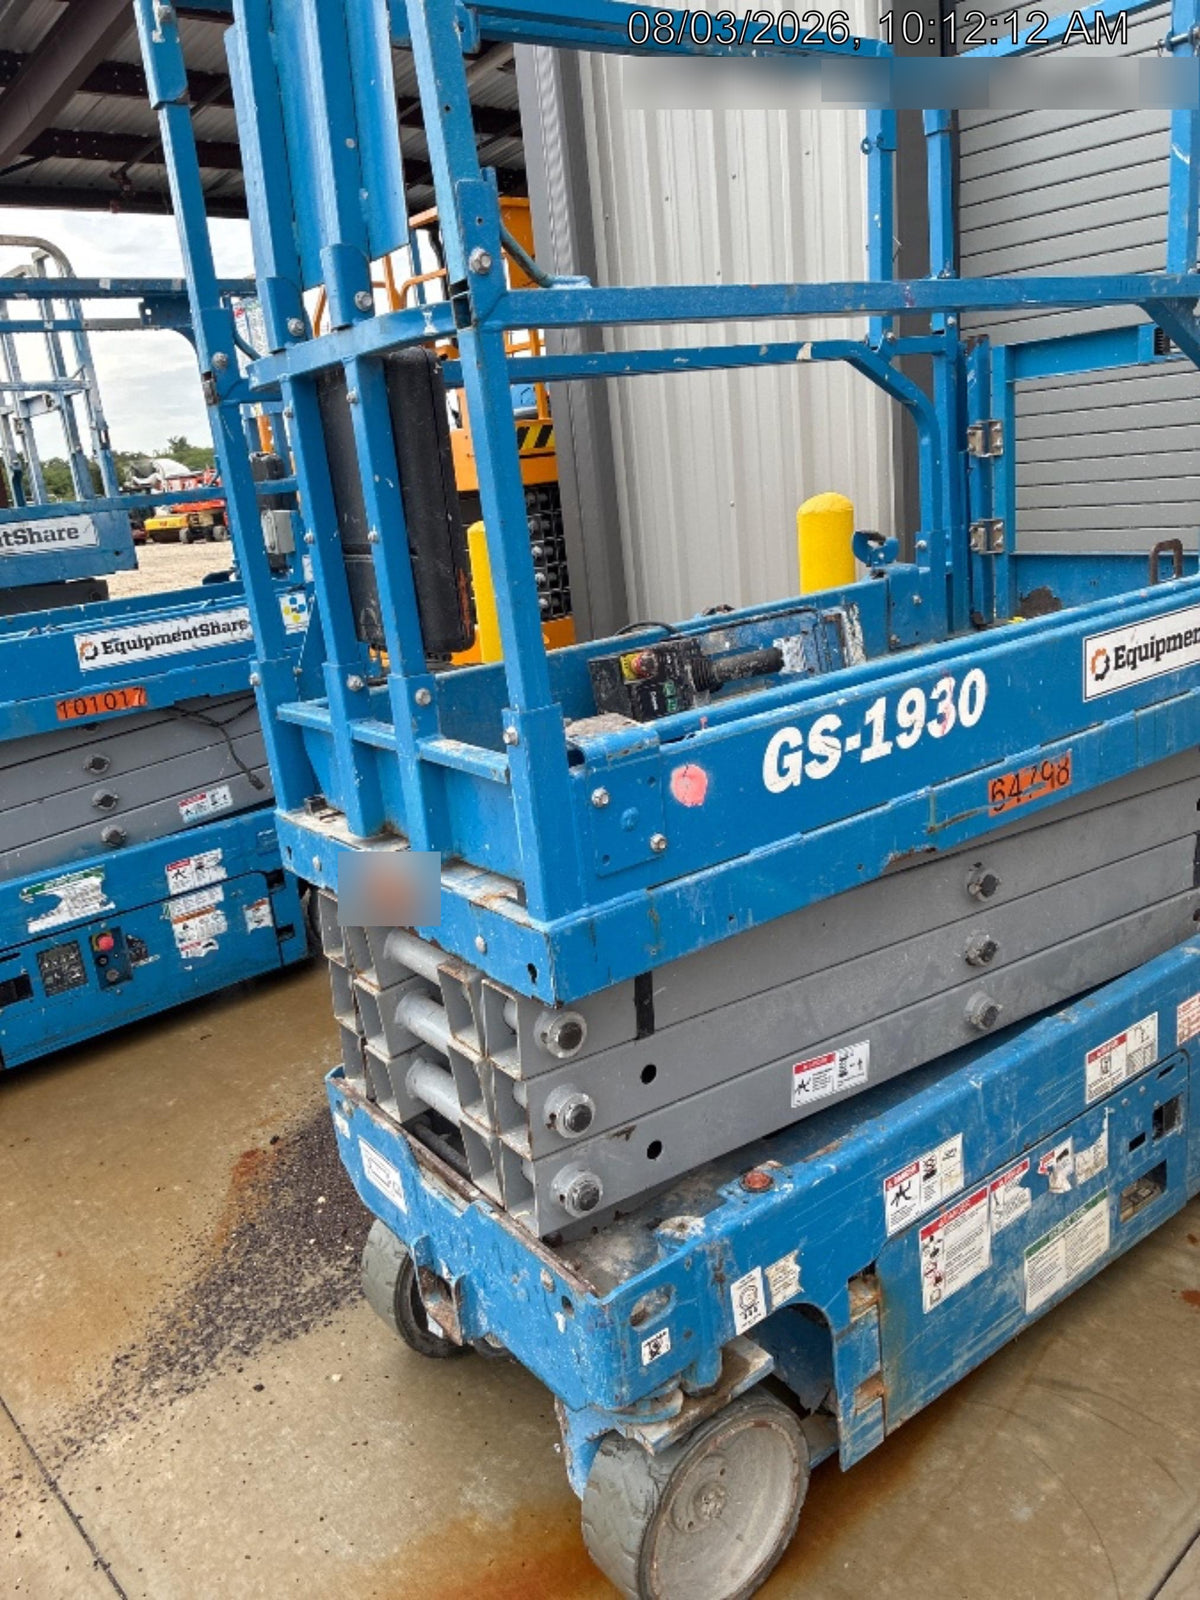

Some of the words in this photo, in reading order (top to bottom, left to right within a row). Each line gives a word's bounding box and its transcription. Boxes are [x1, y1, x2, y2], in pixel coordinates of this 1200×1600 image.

[0, 526, 80, 548] tShare
[101, 618, 249, 656] EquipmentShare
[58, 688, 145, 718] 101017
[761, 668, 988, 794] GS-1930
